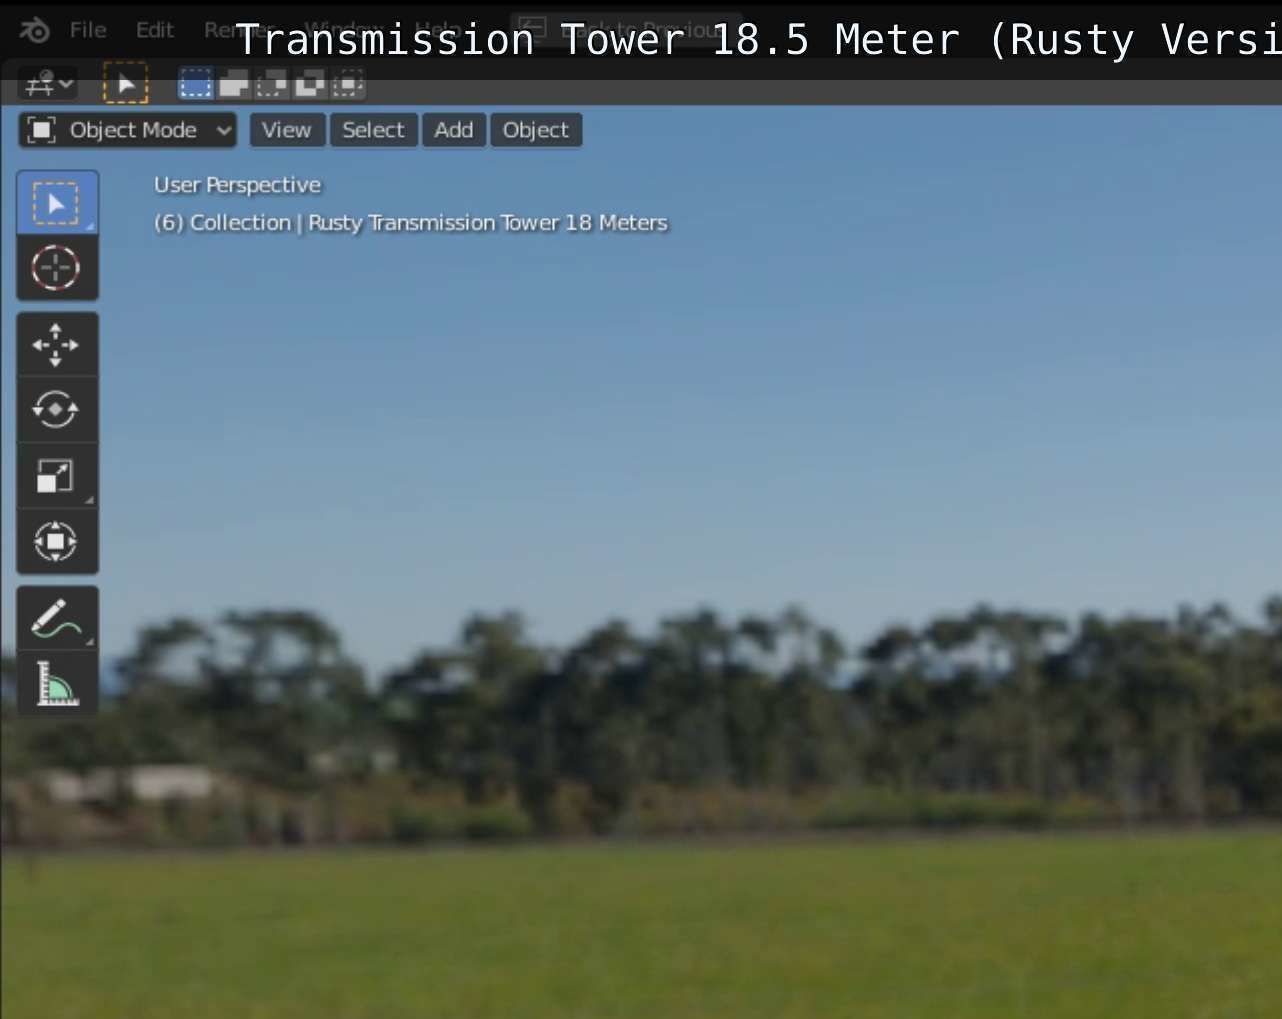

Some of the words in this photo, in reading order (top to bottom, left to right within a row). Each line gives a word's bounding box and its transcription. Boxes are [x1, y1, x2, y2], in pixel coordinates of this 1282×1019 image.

[71, 21, 106, 38] File
[137, 22, 174, 38] Edit
[70, 121, 137, 142] Object
[143, 121, 197, 138] Mode
[262, 121, 312, 138] View
[343, 121, 405, 138] Select
[434, 121, 473, 138] Add
[503, 120, 569, 142] Object
[153, 176, 202, 195] User
[206, 176, 322, 201] Perspective
[153, 213, 184, 235] (6)
[190, 213, 295, 232] Collection
[308, 213, 363, 238] Rusty
[367, 213, 496, 232] Transmission
[499, 213, 560, 232] Tower
[566, 213, 593, 232] 18
[599, 213, 668, 232] Meters
